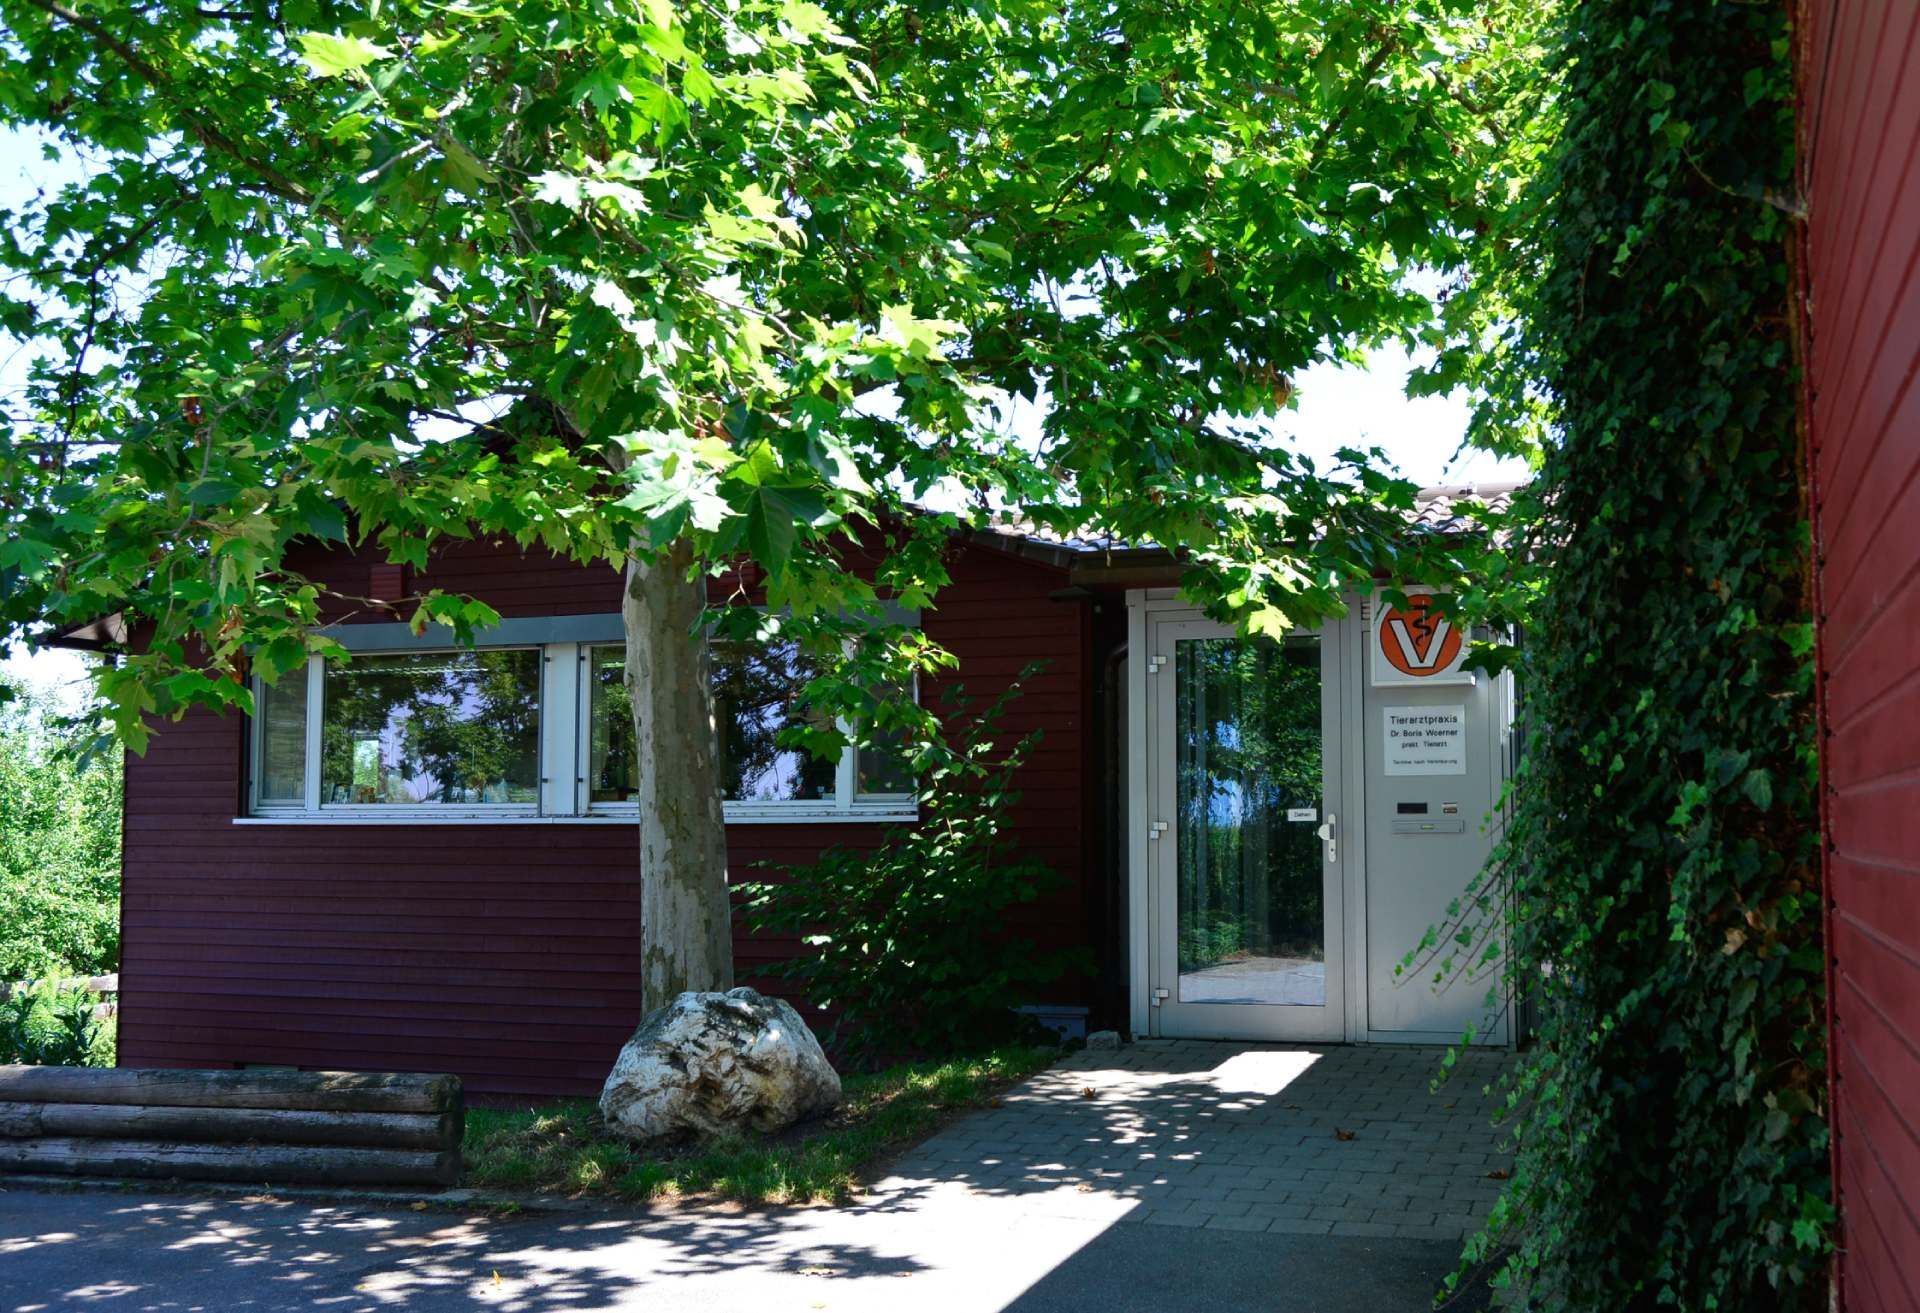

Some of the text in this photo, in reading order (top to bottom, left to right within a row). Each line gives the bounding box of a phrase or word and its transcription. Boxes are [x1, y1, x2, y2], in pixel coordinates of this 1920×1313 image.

[1390, 714, 1458, 725] Tierarztpraxis
[1403, 729, 1422, 737] Boris
[1425, 729, 1458, 737] Woerner
